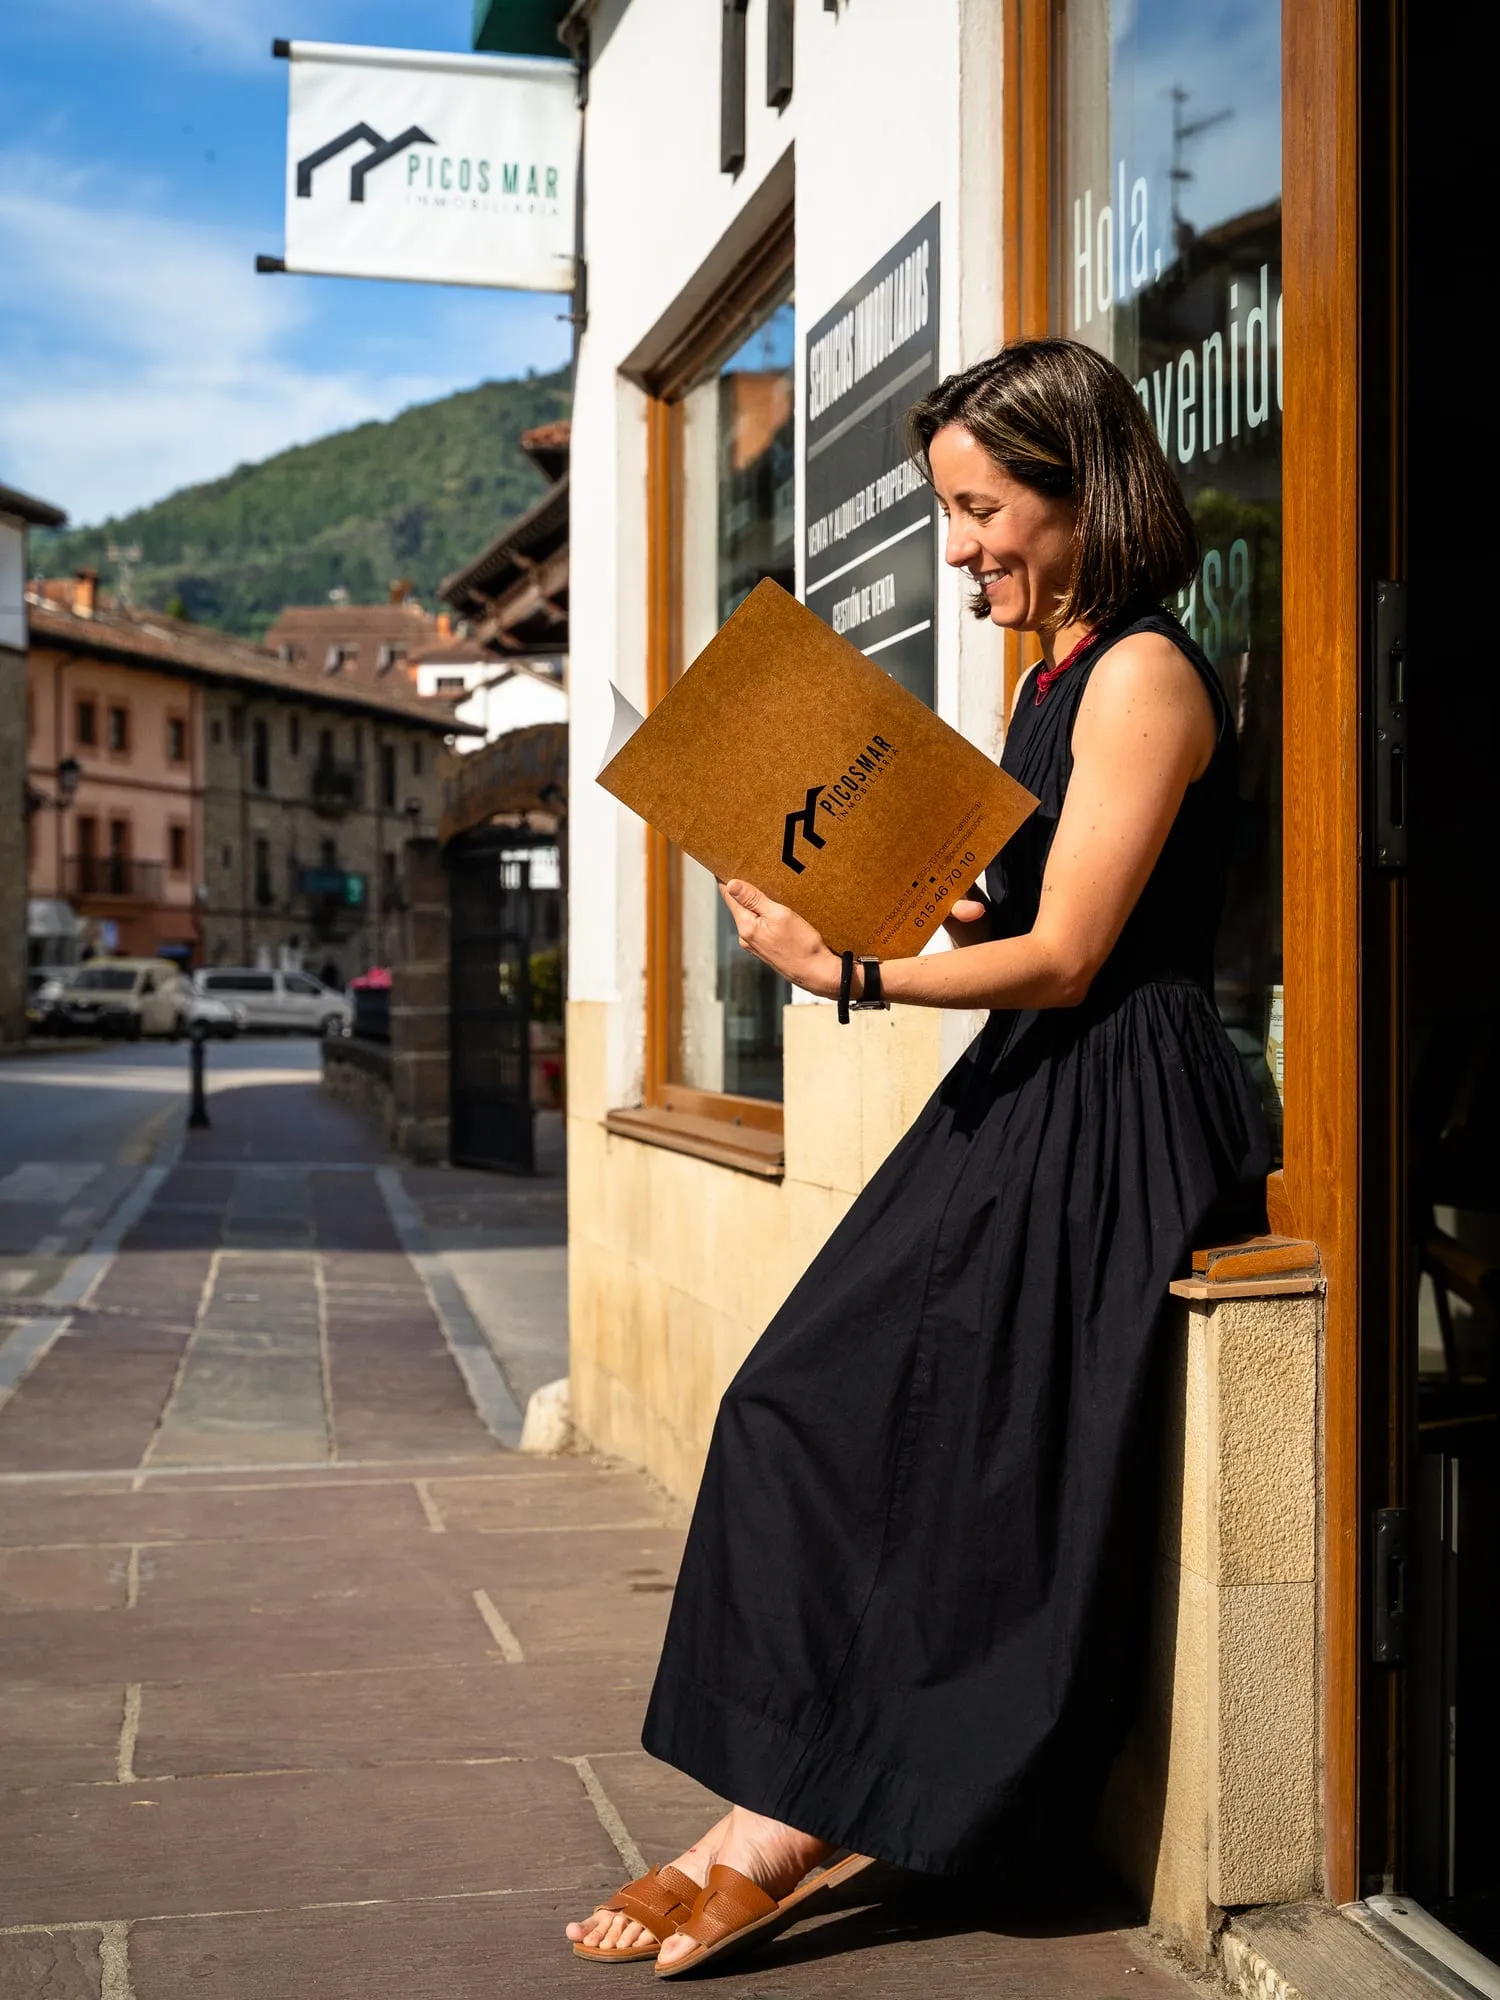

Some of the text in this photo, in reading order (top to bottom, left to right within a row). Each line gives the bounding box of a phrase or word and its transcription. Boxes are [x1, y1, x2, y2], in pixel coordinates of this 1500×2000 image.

[1073, 160, 1162, 332] Hola,
[819, 734, 893, 817] PICOSMAR
[836, 747, 900, 823] INMOBILIARIA
[914, 851, 976, 928] 615 46 70 10
